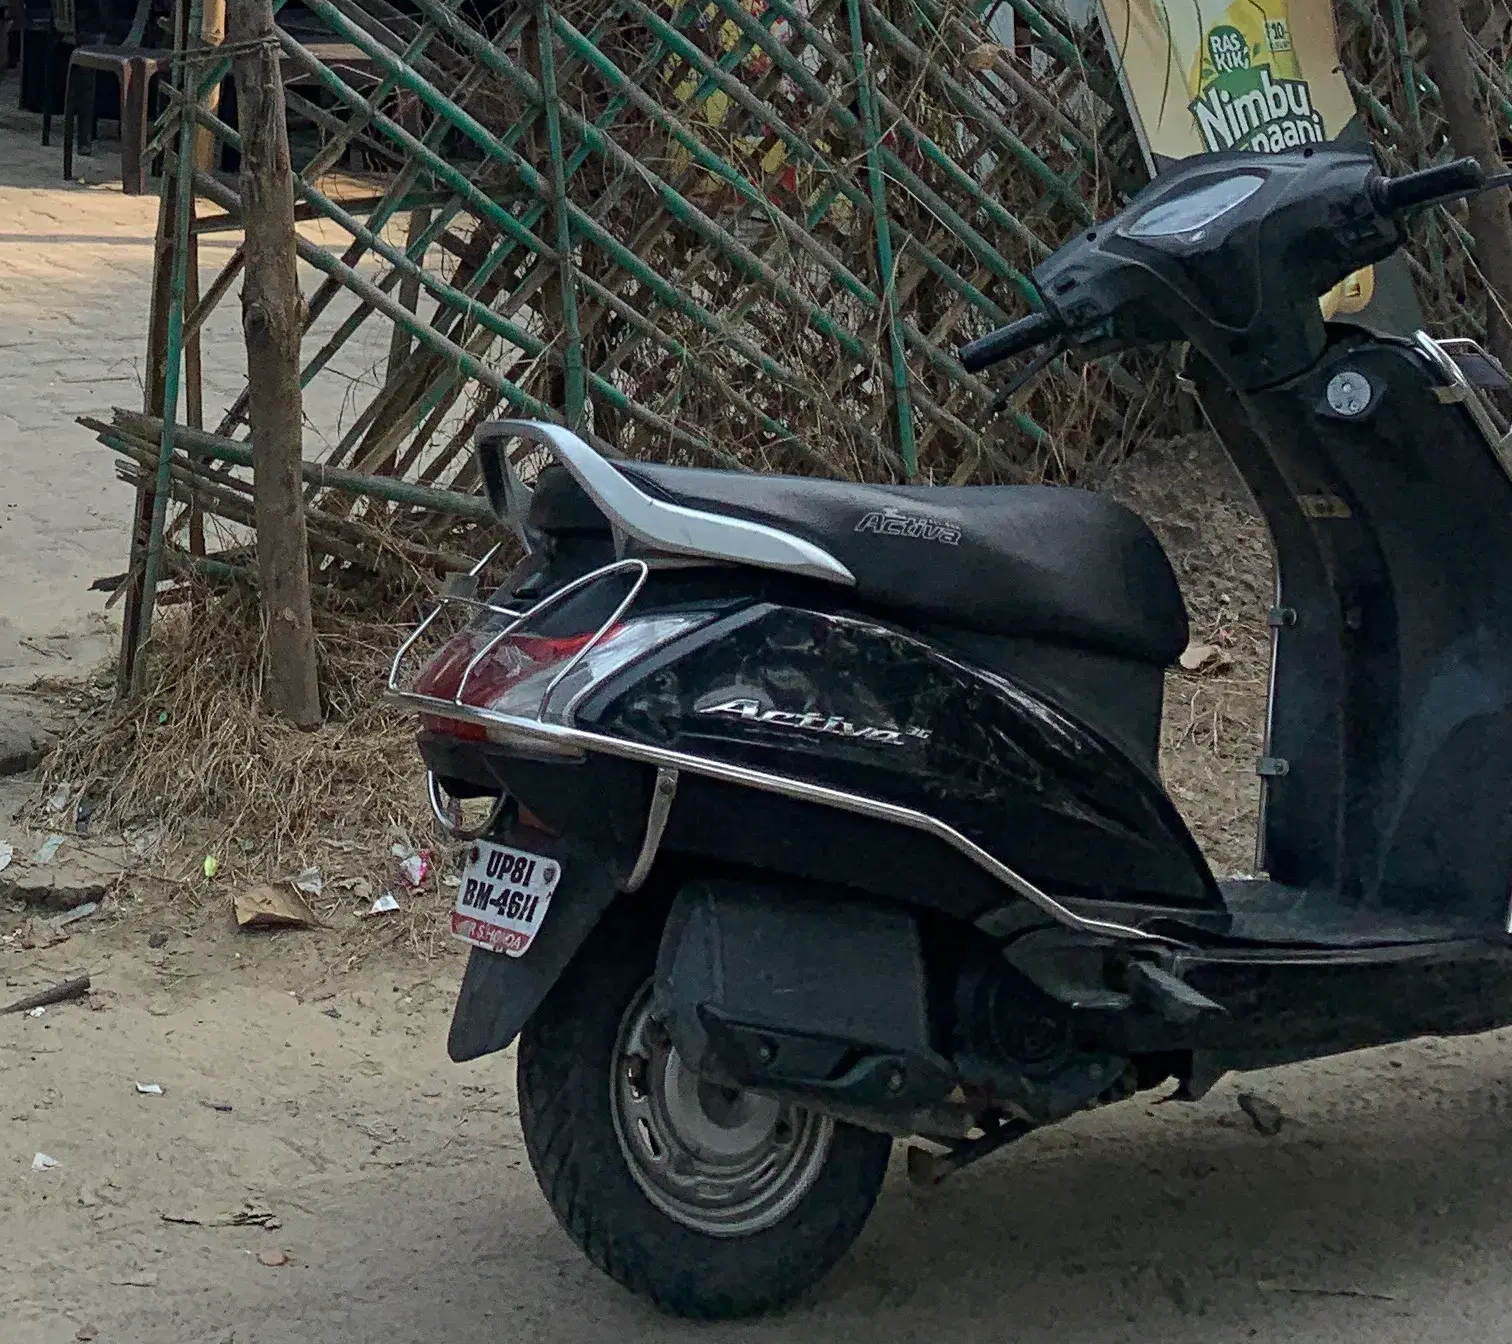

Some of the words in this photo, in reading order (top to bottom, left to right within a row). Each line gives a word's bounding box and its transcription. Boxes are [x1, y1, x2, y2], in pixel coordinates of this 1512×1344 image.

[1210, 33, 1241, 54] RAS
[1196, 70, 1311, 152] Nimbu
[854, 512, 962, 546] Activa
[699, 699, 905, 746] Activa
[486, 850, 536, 887] UP81
